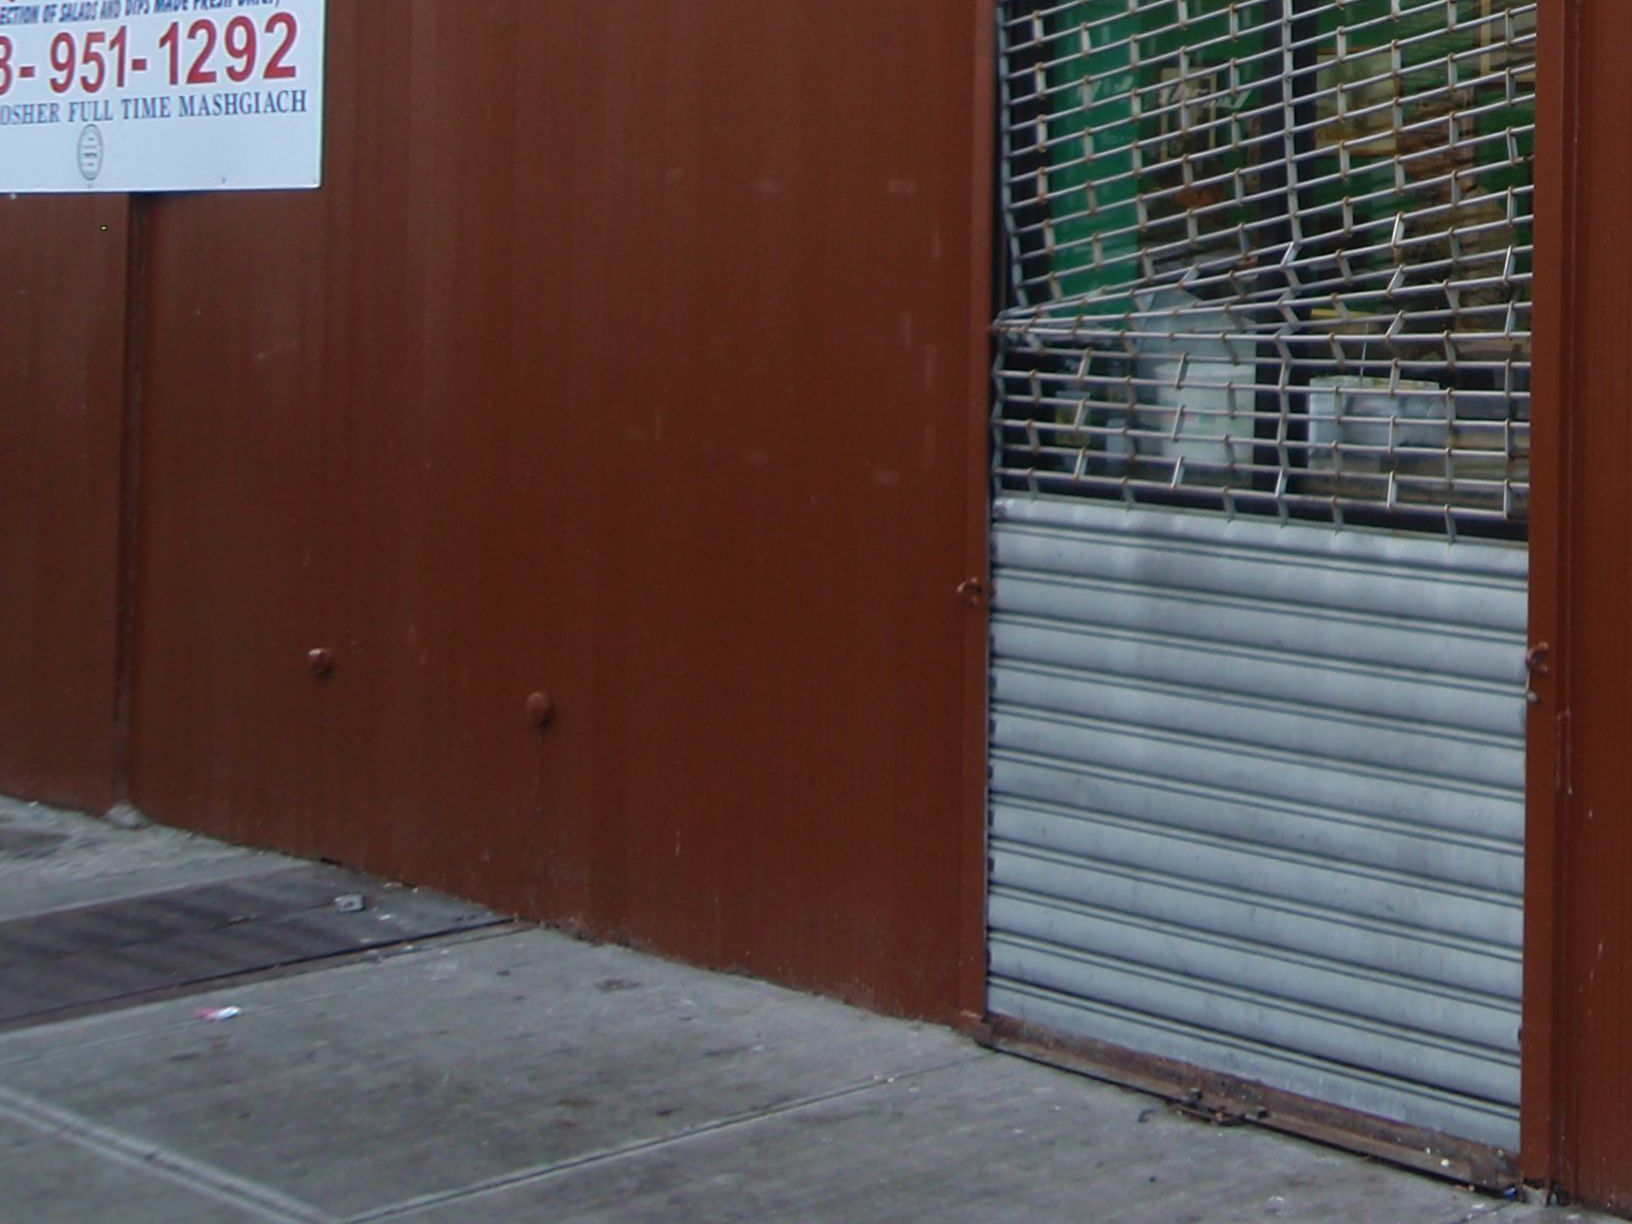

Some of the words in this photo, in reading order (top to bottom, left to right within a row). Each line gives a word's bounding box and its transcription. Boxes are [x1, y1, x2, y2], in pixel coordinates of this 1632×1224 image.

[43, 3, 57, 23] OF
[59, 0, 98, 22] SALADS
[0, 103, 60, 125] OSHER
[68, 100, 113, 123] FULL
[121, 95, 171, 120] TIME
[178, 89, 307, 117] MASHGIACH
